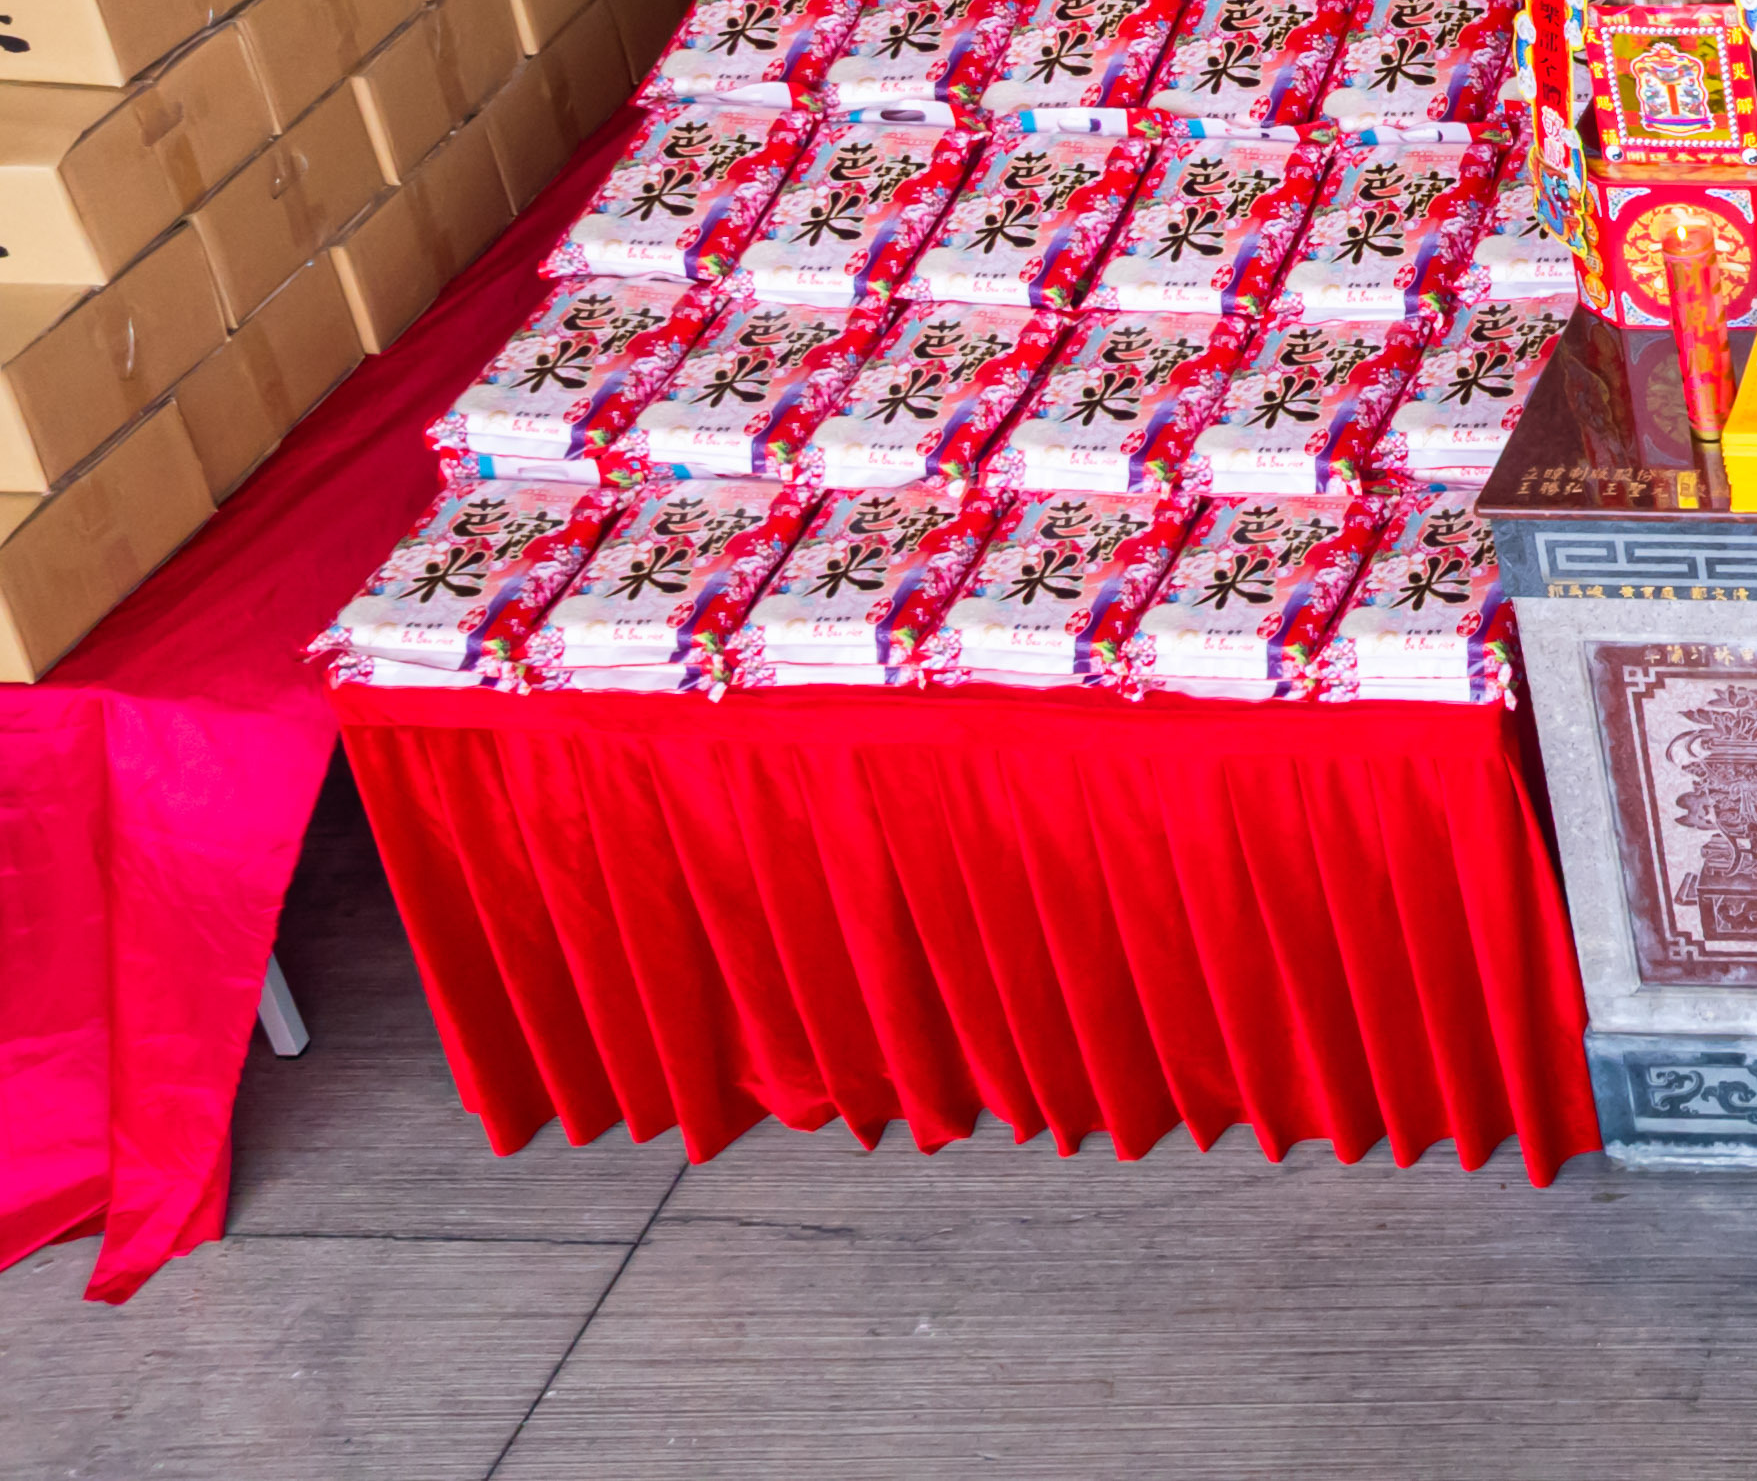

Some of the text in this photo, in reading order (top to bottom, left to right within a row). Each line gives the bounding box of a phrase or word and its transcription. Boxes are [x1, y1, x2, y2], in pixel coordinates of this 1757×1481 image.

[707, 3, 781, 57] 米
[872, 11, 942, 61] 米
[1026, 28, 1094, 84] 米
[1192, 40, 1262, 94] 米
[1367, 37, 1438, 93] 米
[620, 168, 699, 222] 米
[787, 191, 866, 247] 米
[964, 199, 1038, 255] 米
[1154, 206, 1226, 264] 米
[1336, 210, 1408, 265] 米
[508, 339, 596, 394] 米
[689, 354, 772, 408] 米
[1438, 350, 1515, 407] 米
[861, 368, 944, 424] 米
[1068, 371, 1139, 427] 米
[1243, 374, 1323, 429] 米
[395, 543, 489, 604] 米
[603, 544, 694, 601] 米
[801, 543, 888, 599] 米
[998, 549, 1085, 606] 米
[1190, 555, 1276, 611] 米
[1388, 556, 1471, 611] 米
